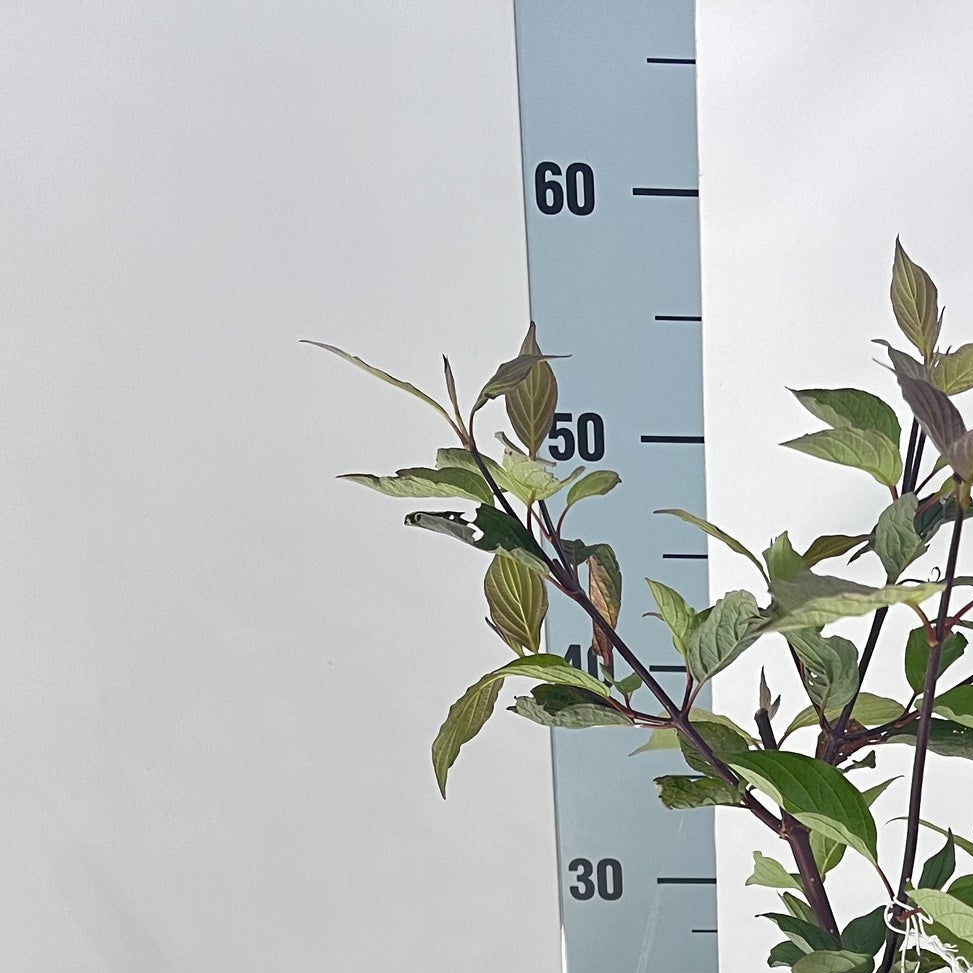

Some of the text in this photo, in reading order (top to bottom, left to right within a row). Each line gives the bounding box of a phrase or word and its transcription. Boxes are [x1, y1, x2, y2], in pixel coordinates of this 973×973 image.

[535, 161, 595, 216] 60
[548, 412, 605, 462] 50
[568, 858, 623, 901] 30
